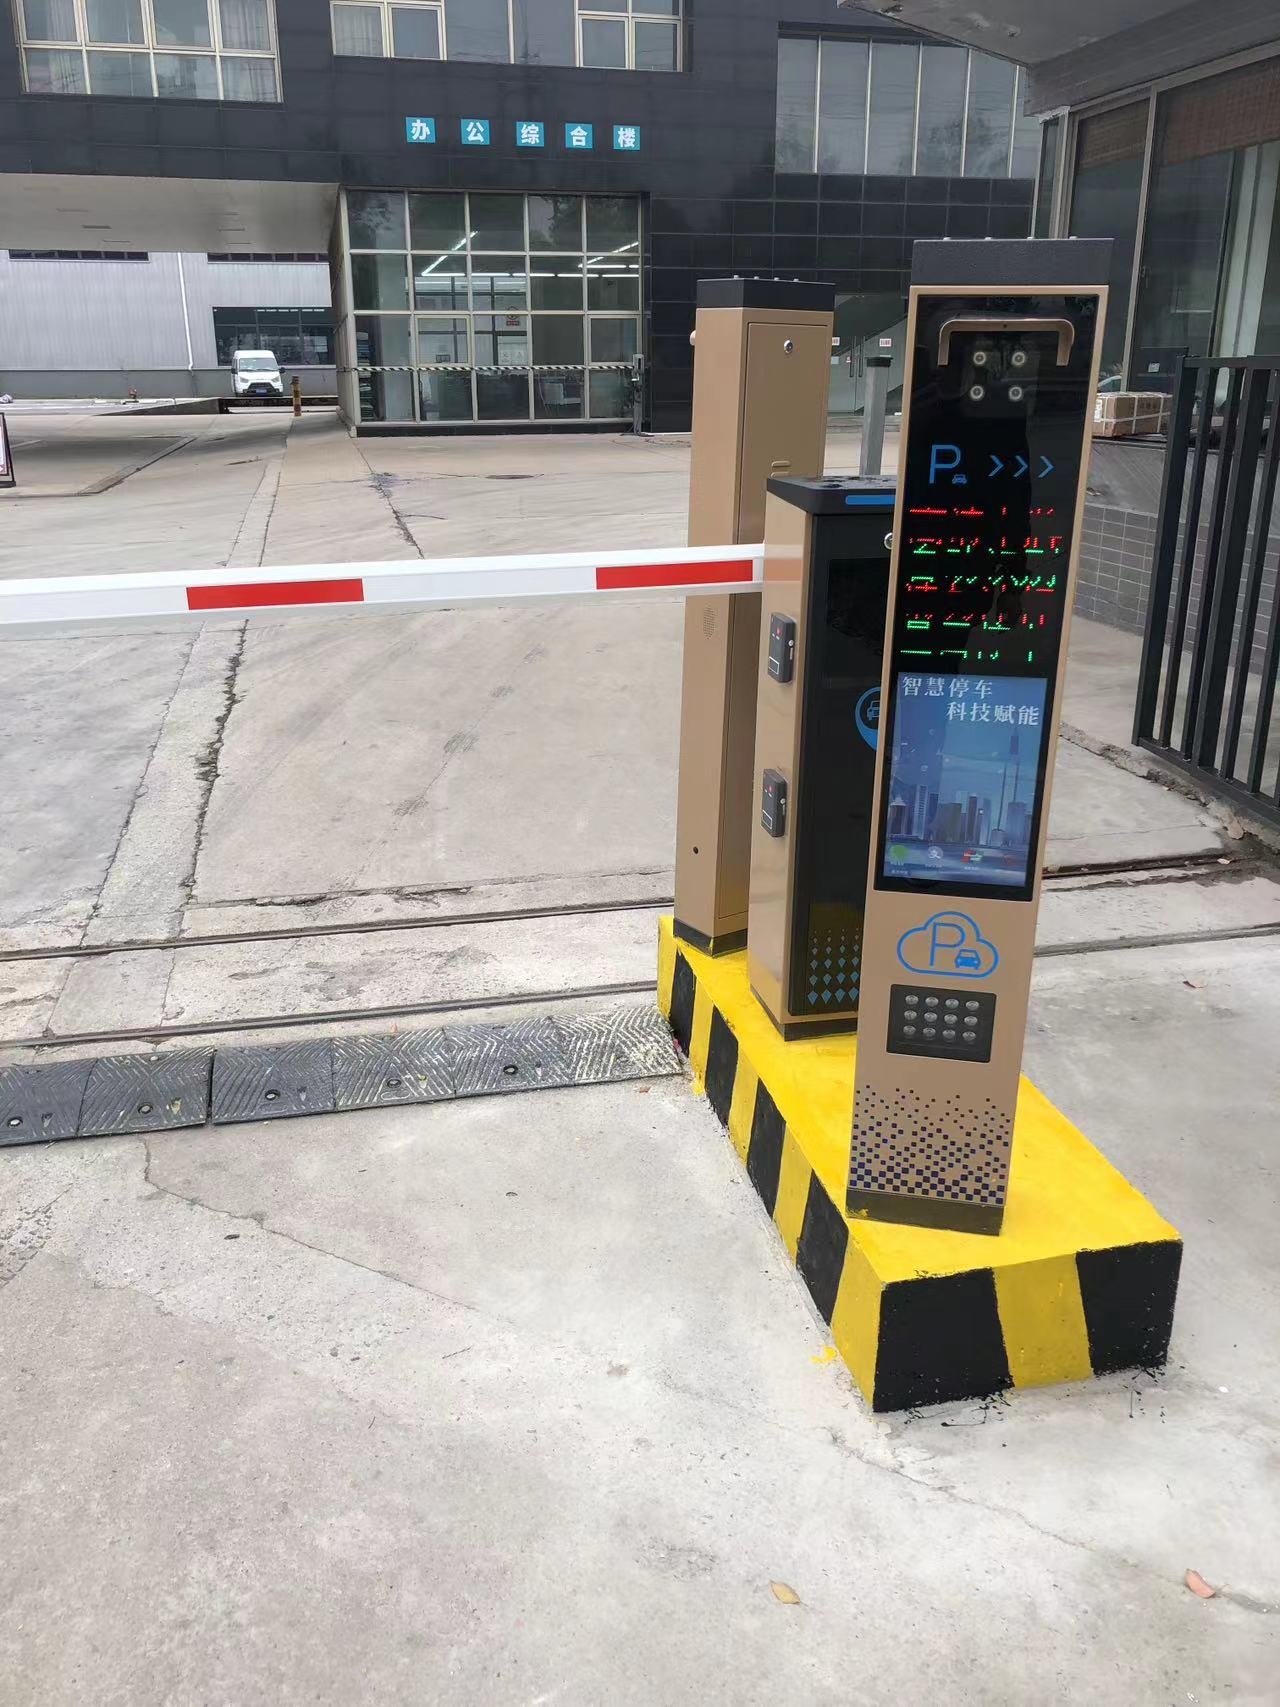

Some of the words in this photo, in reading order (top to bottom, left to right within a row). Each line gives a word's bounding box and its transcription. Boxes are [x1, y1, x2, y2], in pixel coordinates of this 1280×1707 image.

[410, 118, 636, 148] 办公综合楼
[929, 444, 962, 484] P
[902, 675, 993, 700] 智慧停车
[946, 701, 1040, 726] 科技赋能
[930, 922, 966, 967] P
